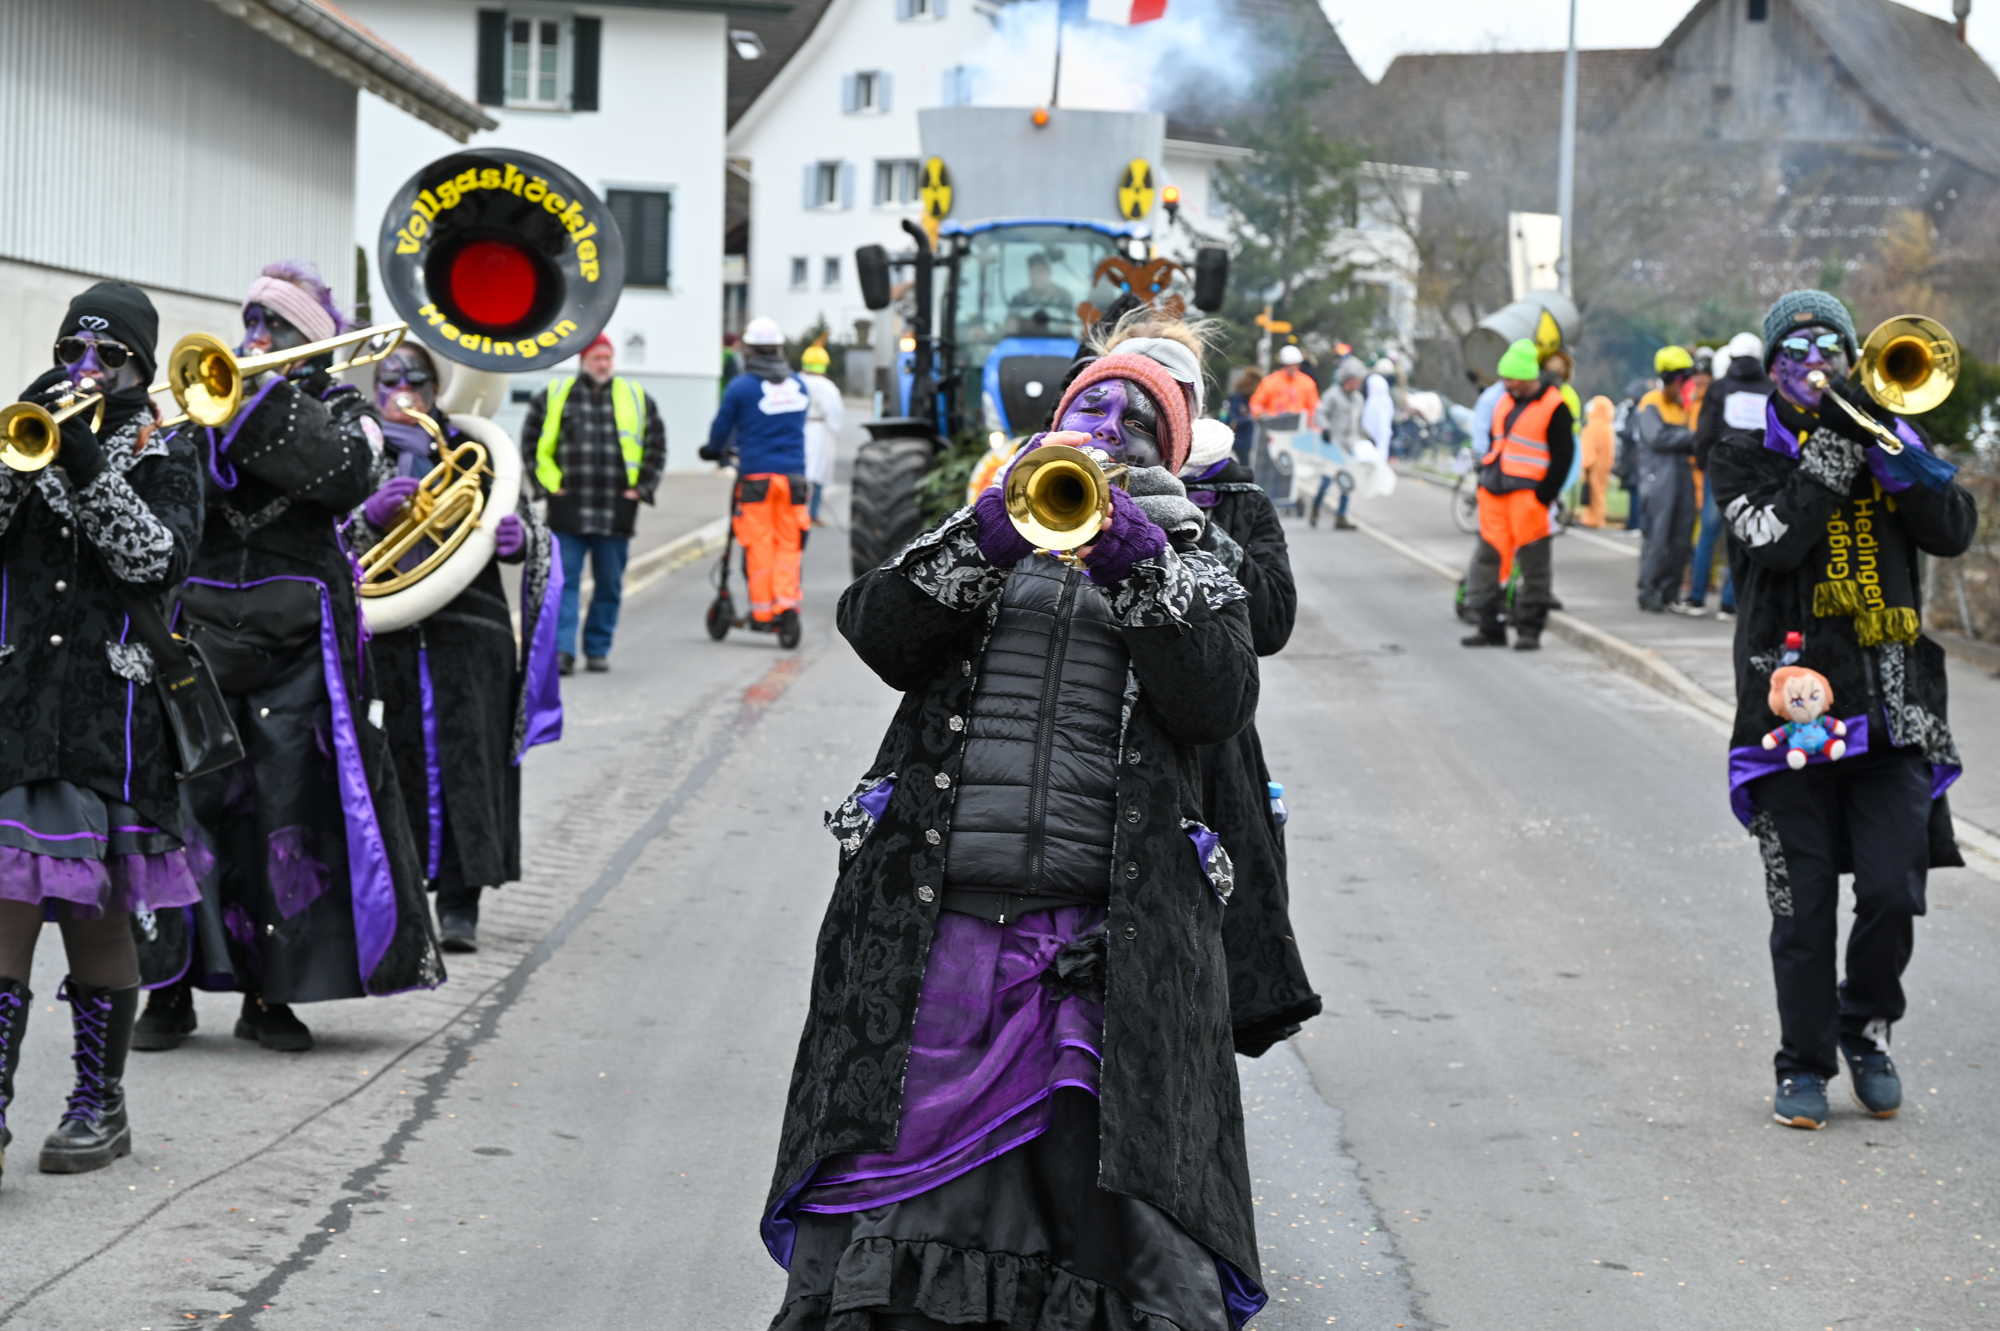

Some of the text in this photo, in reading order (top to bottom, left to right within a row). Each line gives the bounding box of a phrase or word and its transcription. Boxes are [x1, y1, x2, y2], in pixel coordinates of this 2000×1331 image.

[396, 163, 600, 283] Vollgashöckler
[418, 303, 578, 358] Hedingen
[1854, 498, 1885, 612] Hedingen
